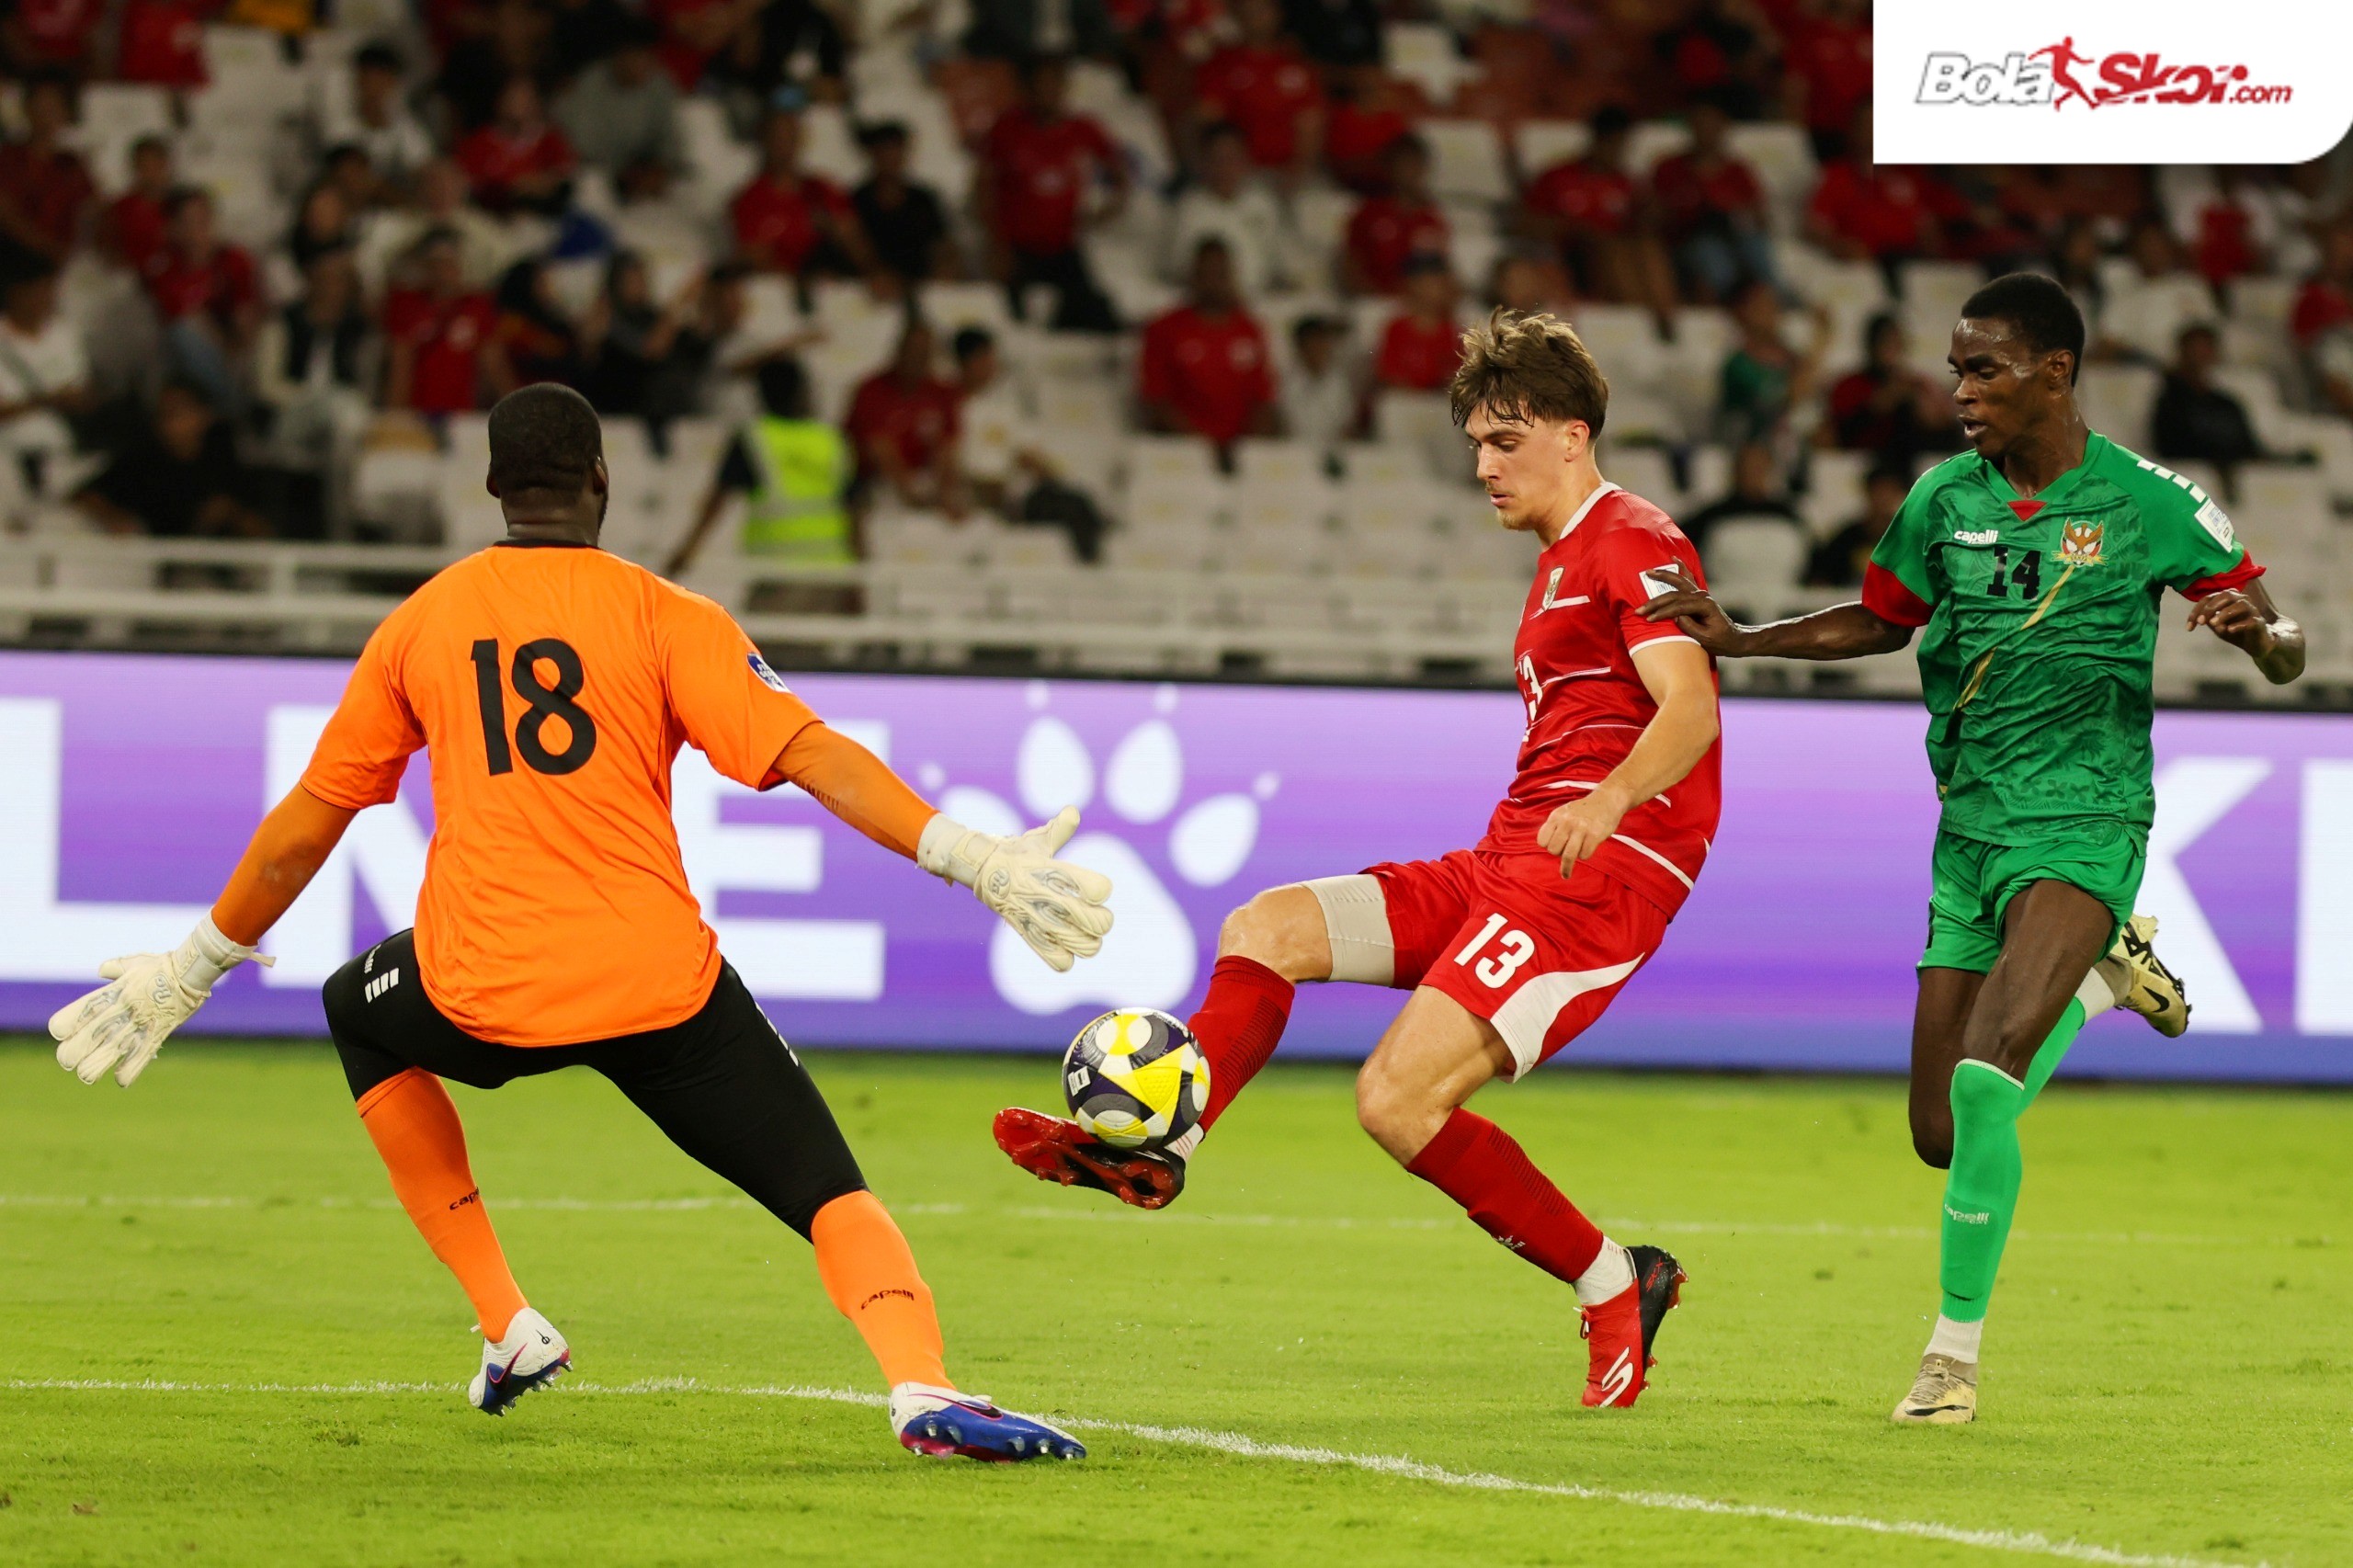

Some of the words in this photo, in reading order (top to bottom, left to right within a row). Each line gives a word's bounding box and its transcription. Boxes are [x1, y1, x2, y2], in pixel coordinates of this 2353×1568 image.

[1953, 528, 1999, 545] capelli
[1986, 545, 2041, 601] 14
[471, 637, 597, 777] 18
[1453, 912, 1536, 990] 13
